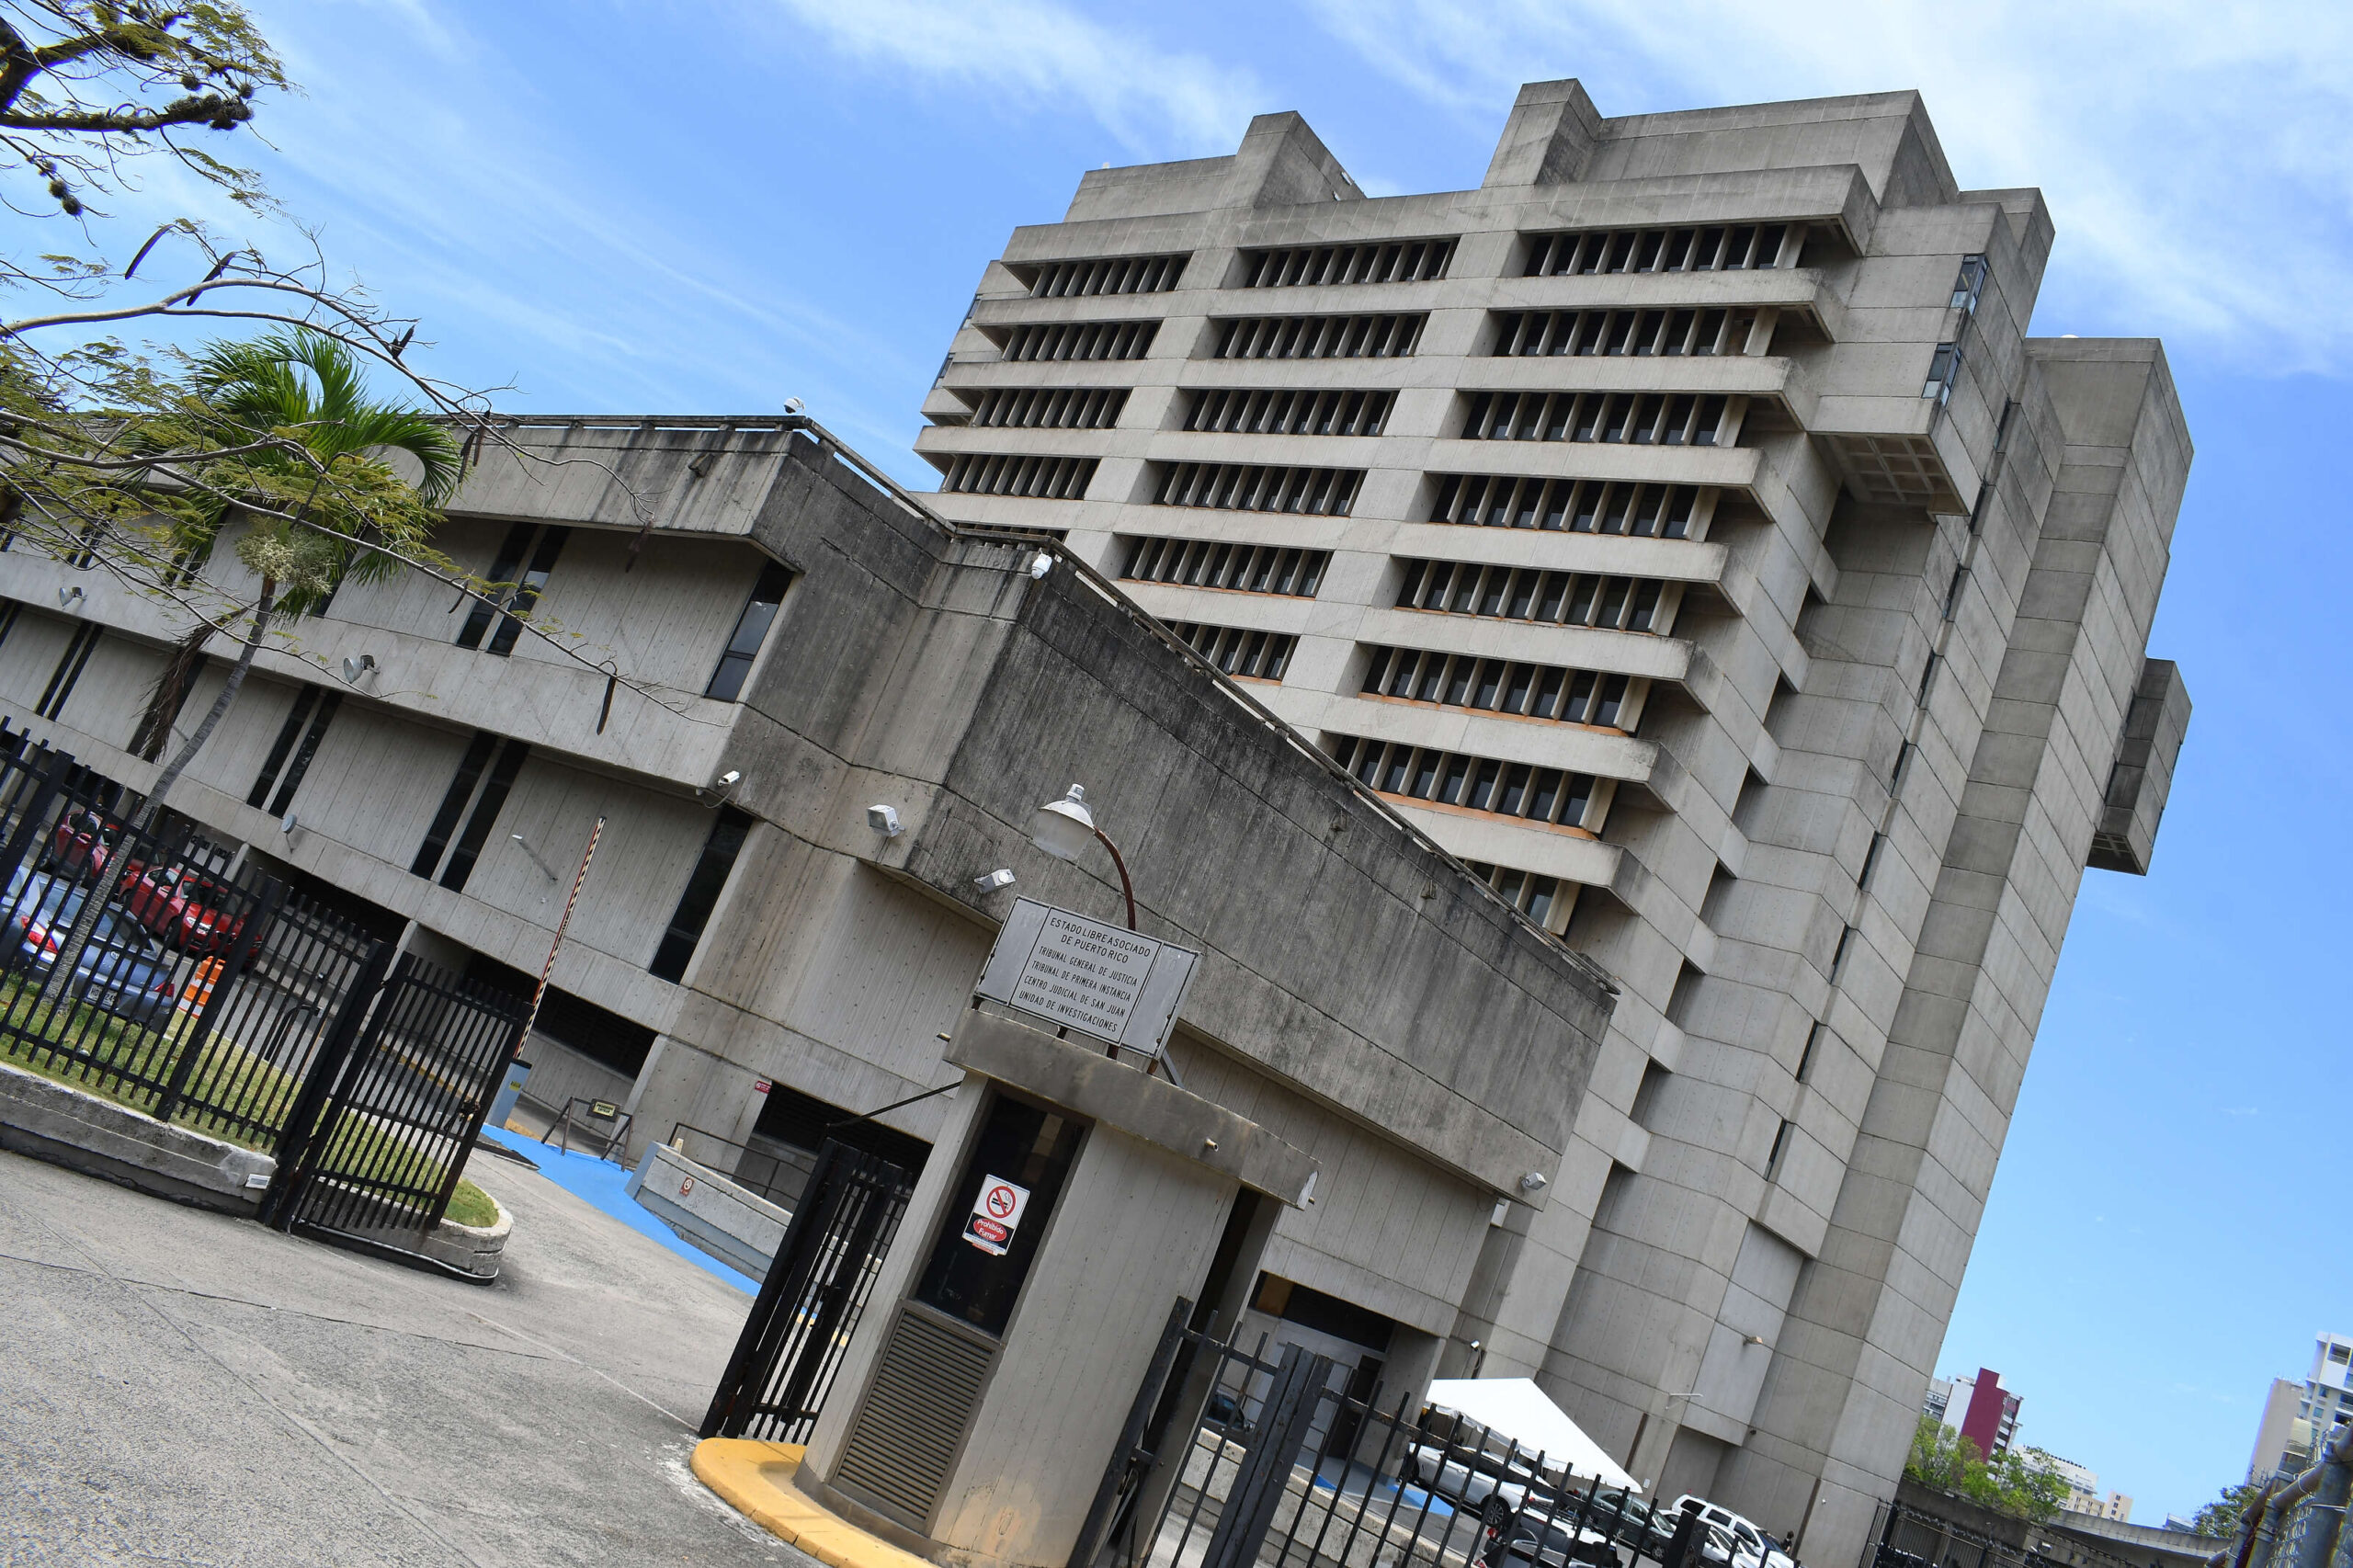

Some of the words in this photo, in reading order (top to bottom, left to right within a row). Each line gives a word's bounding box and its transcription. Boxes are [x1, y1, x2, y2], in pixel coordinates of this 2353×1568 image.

[1050, 917, 1082, 935] ESTADO
[1082, 928, 1108, 943] LIBRE
[1107, 937, 1151, 957] ASOCIADO
[1061, 935, 1073, 945] DE
[1074, 938, 1107, 956] PUERTO
[1108, 949, 1129, 963] RICO
[1031, 960, 1059, 977] TRIBUNAL
[1061, 971, 1070, 981] DE
[1071, 974, 1097, 990] PRIMERA
[1098, 983, 1131, 1002] INSTANCIA
[1039, 946, 1066, 962] TRIBUNAL
[1069, 957, 1096, 972] GENERAL
[1098, 966, 1108, 976] DE
[1108, 971, 1138, 987] JUSTICIA
[1018, 990, 1044, 1006] UNIDAD
[1045, 999, 1056, 1010] DE
[1057, 1004, 1118, 1032] INVESTIGACIONES
[1024, 975, 1048, 990] CENTRO
[1049, 983, 1077, 1001] JUDICIAL
[1079, 994, 1090, 1005] DE
[1090, 998, 1106, 1011] SAN
[1106, 1004, 1126, 1017] JUAN
[977, 1219, 1004, 1234] Prohibido
[978, 1227, 997, 1240] Fumar
